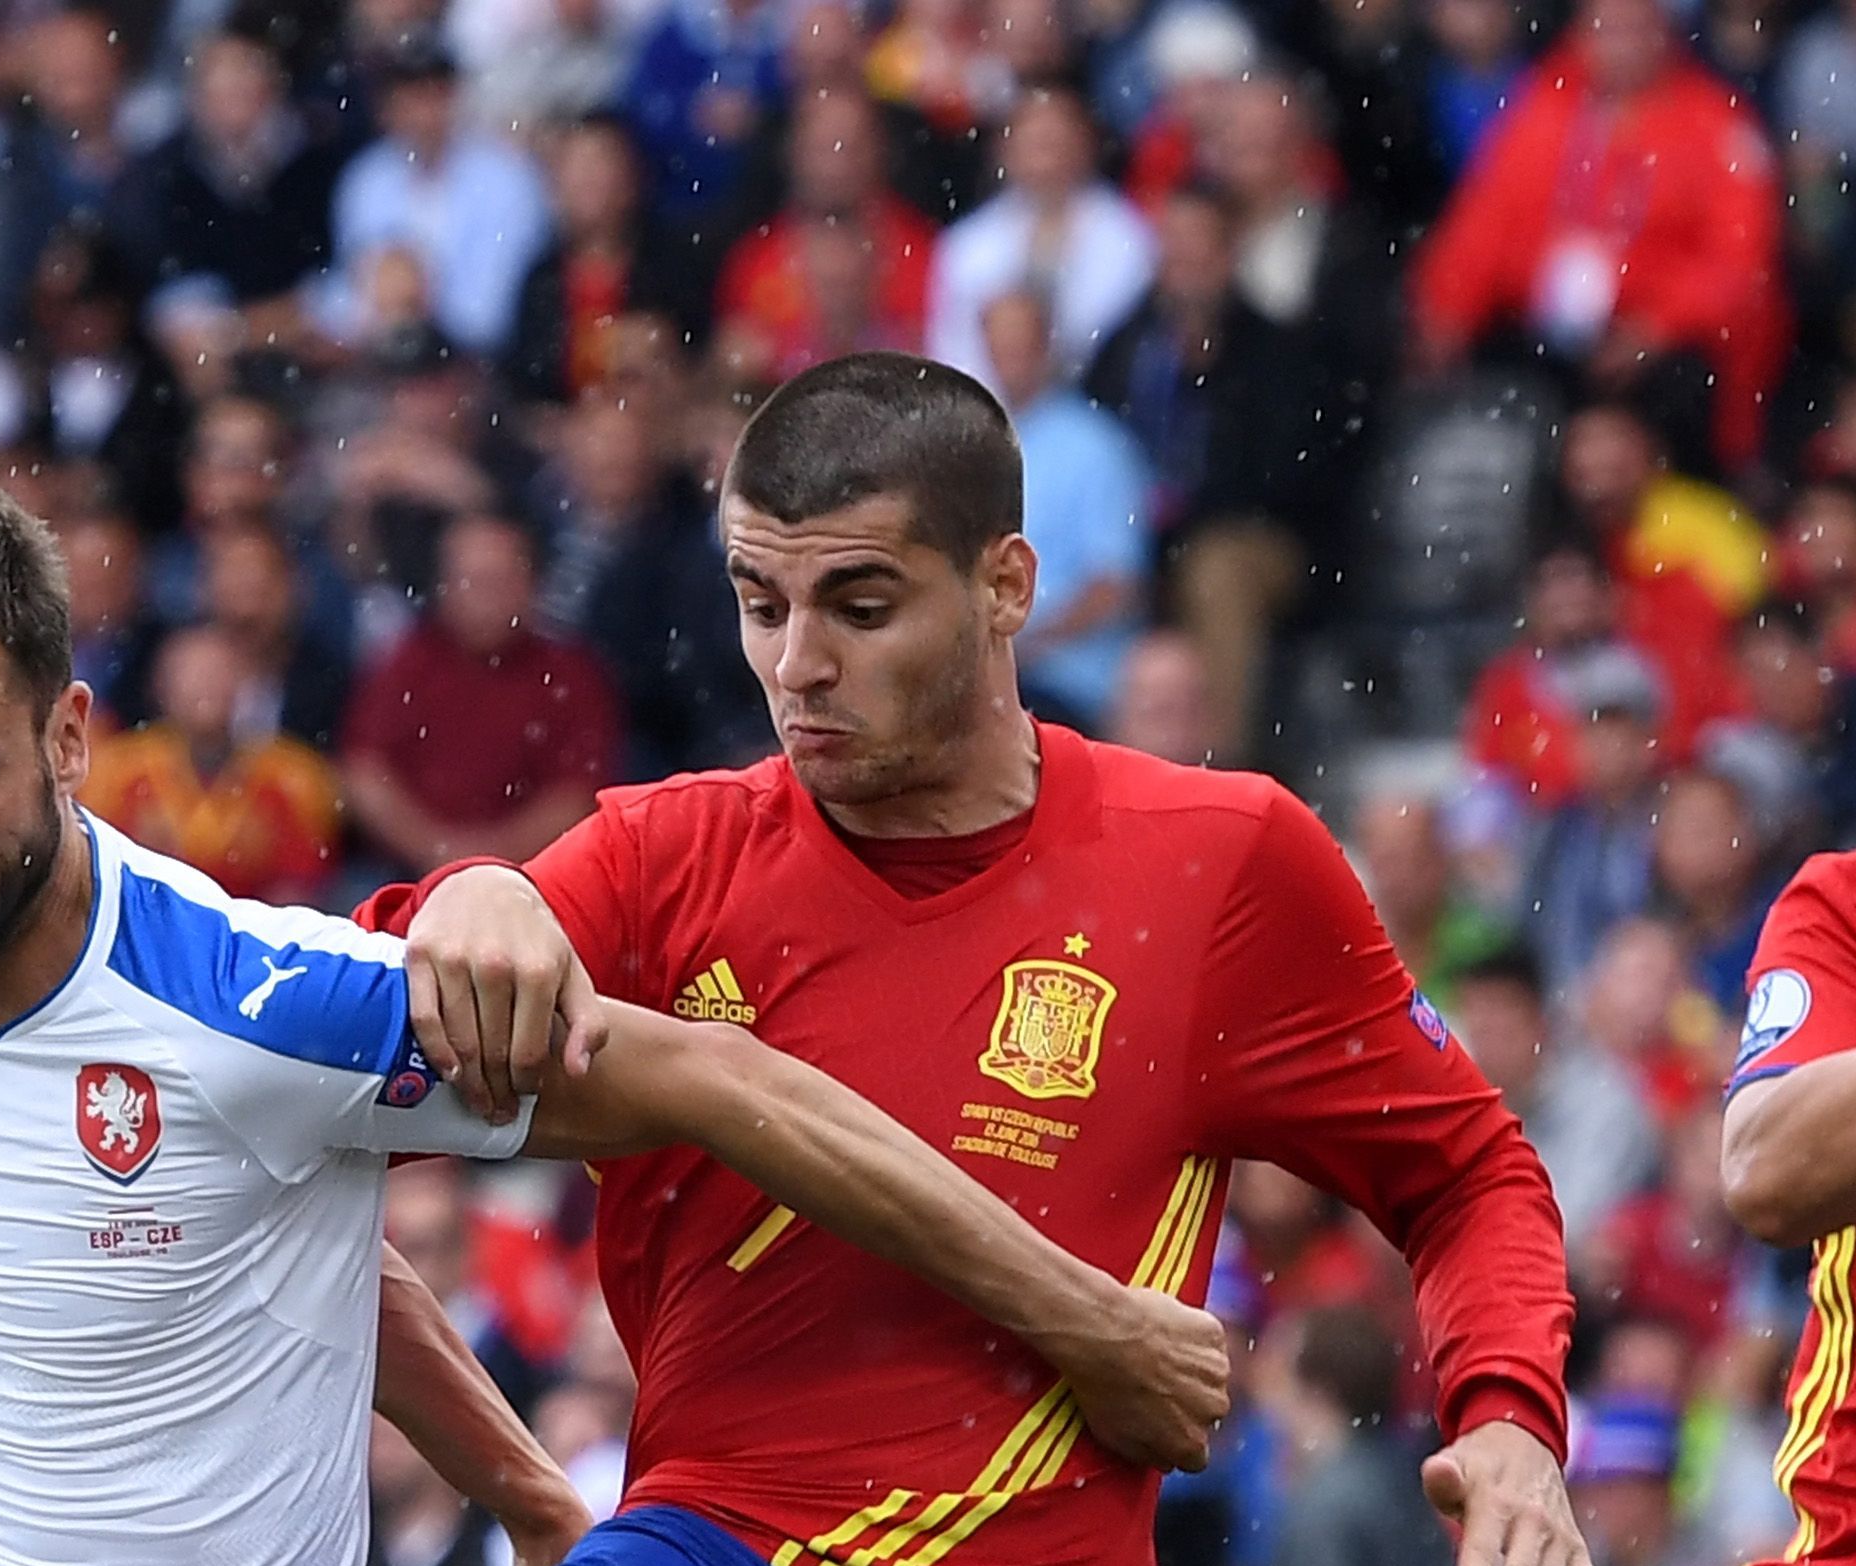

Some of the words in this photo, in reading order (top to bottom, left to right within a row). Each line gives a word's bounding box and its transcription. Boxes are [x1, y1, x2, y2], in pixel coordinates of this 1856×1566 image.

[674, 998, 756, 1025] adidas
[89, 1231, 124, 1249] ESP
[147, 1225, 183, 1245] CZE
